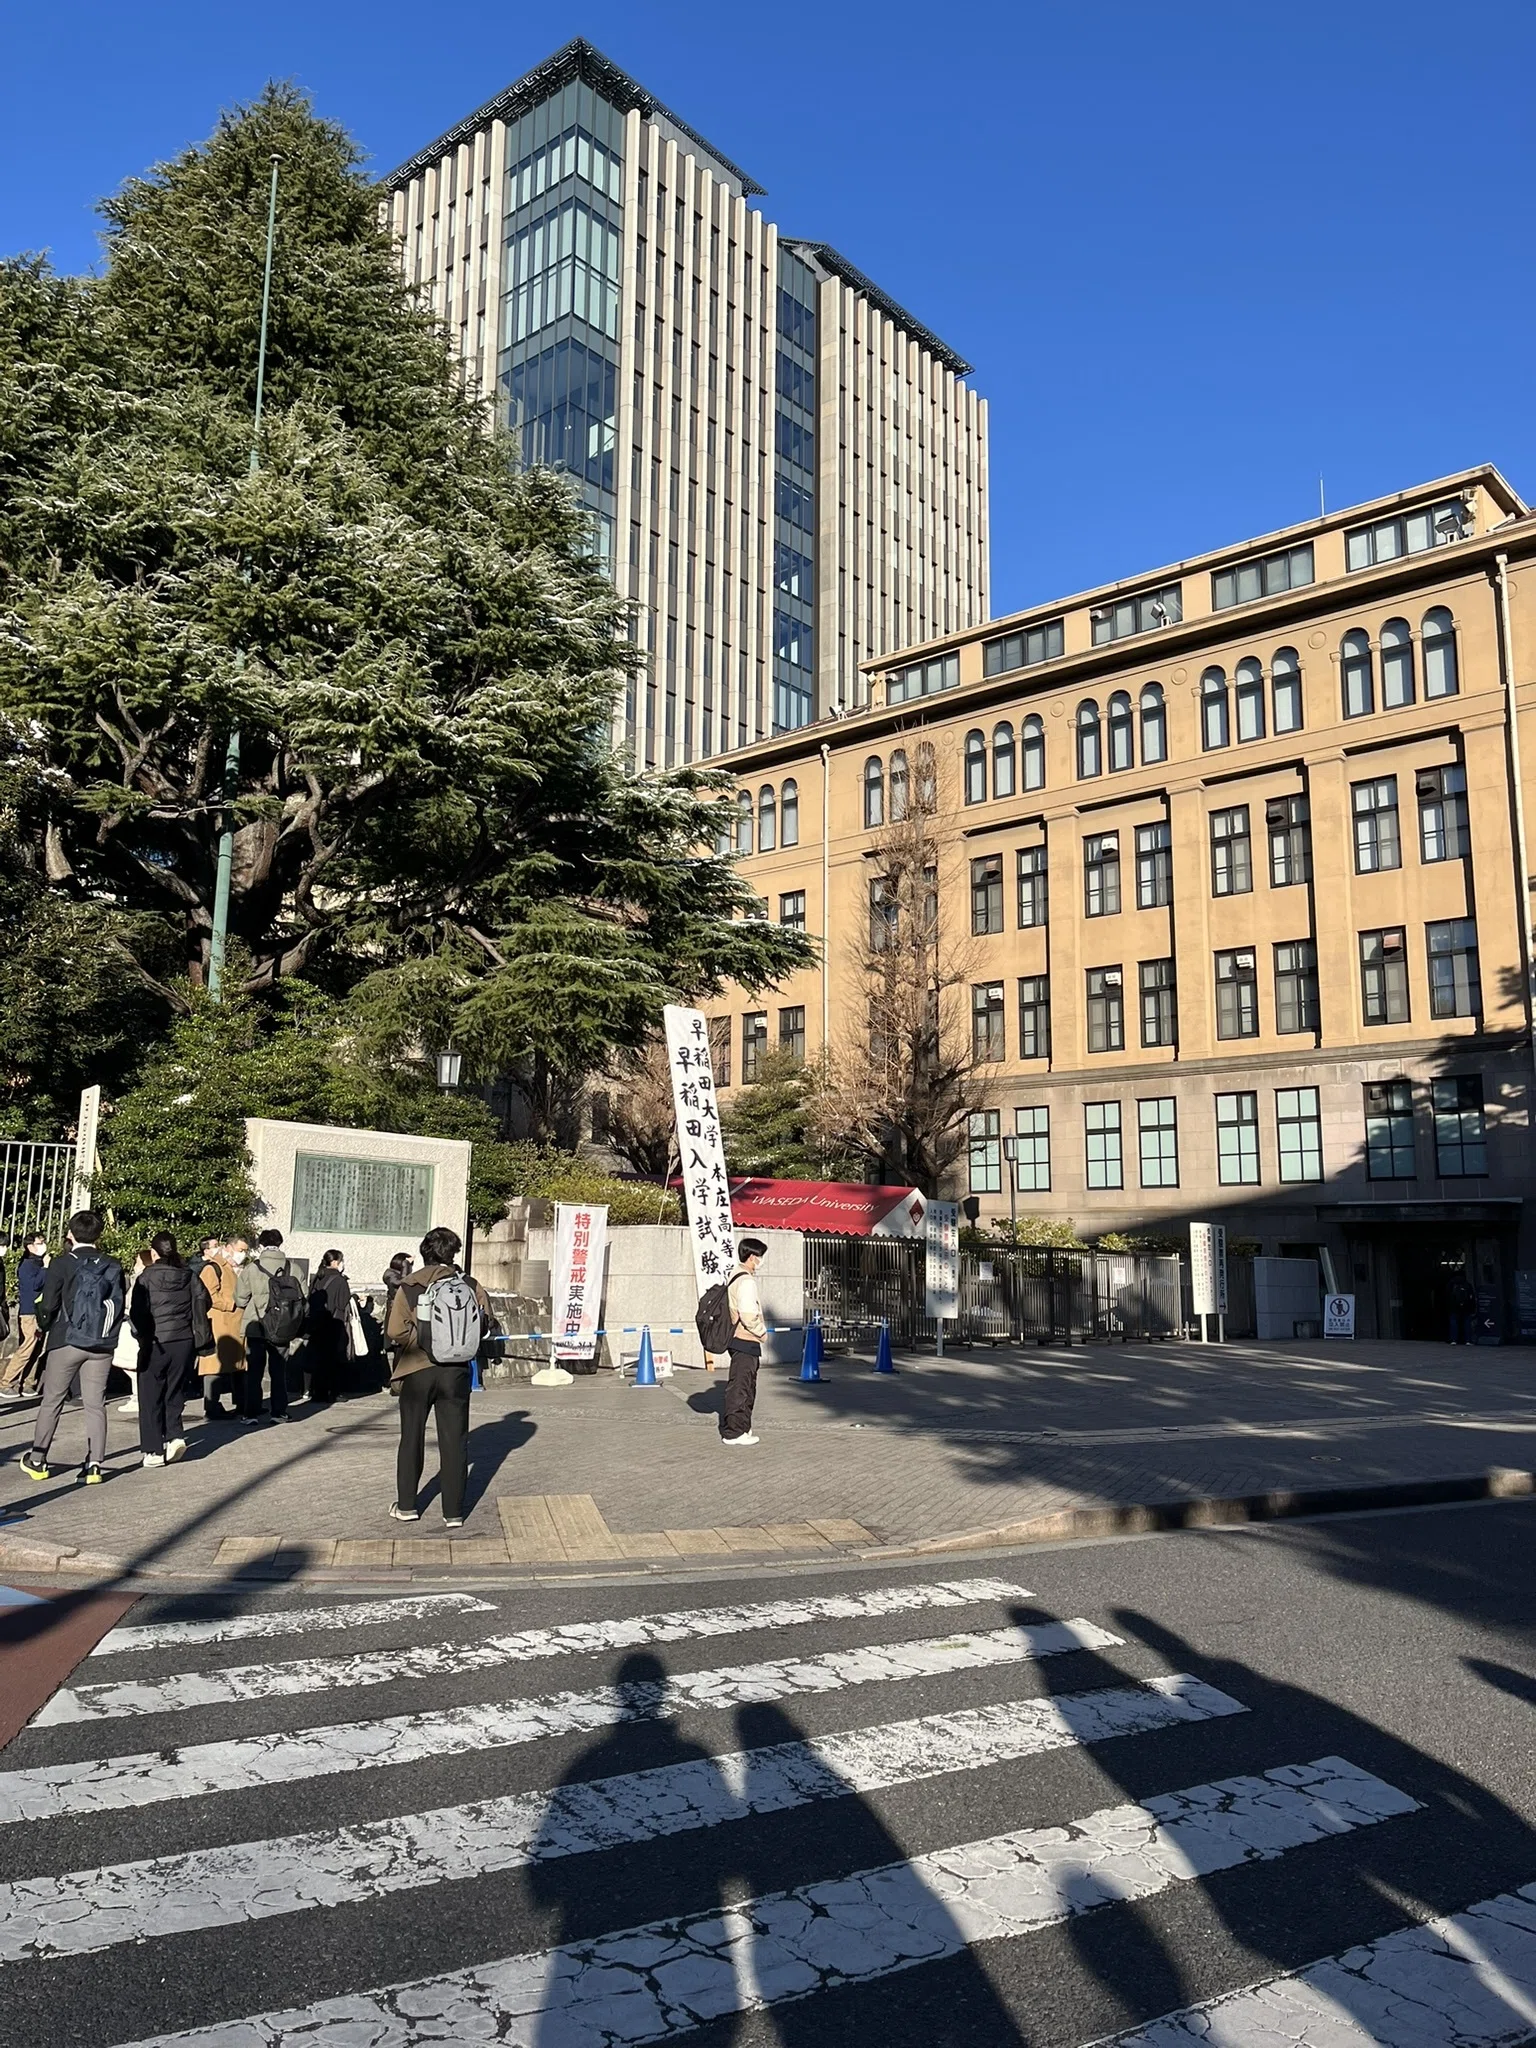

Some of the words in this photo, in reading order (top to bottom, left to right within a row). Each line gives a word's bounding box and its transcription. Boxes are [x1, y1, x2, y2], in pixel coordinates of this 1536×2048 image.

[690, 1018, 718, 1148] 早稲田大学
[675, 1046, 721, 1275] 早稲田入学試験
[752, 1196, 808, 1206] WASEDA
[810, 1195, 879, 1213] University
[565, 1212, 591, 1336] 特別警戒実施中
